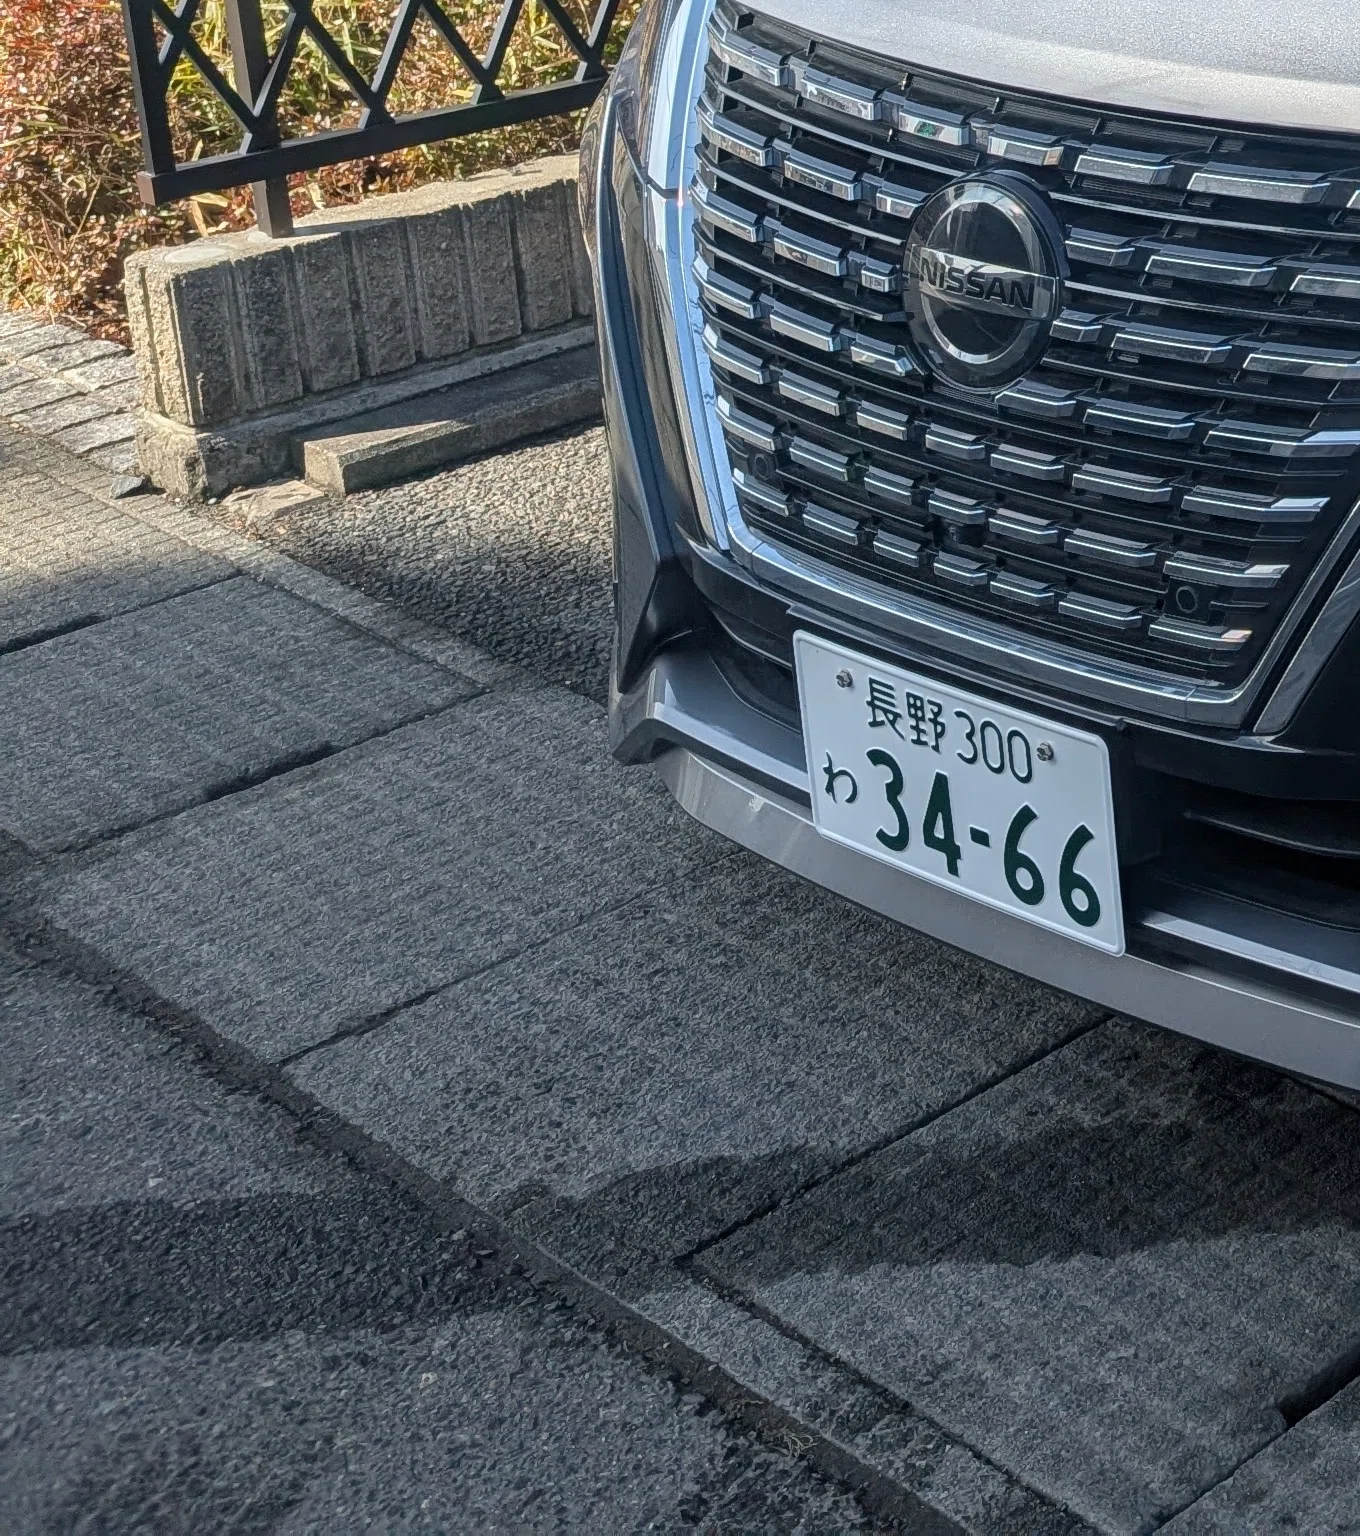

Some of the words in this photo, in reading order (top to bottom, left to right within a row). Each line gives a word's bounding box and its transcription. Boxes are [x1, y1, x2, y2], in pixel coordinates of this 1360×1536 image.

[920, 257, 1035, 311] NISSAN
[866, 677, 946, 754] 長野
[954, 710, 1032, 783] 300
[822, 751, 859, 804] わ
[866, 747, 1102, 928] 34-66
